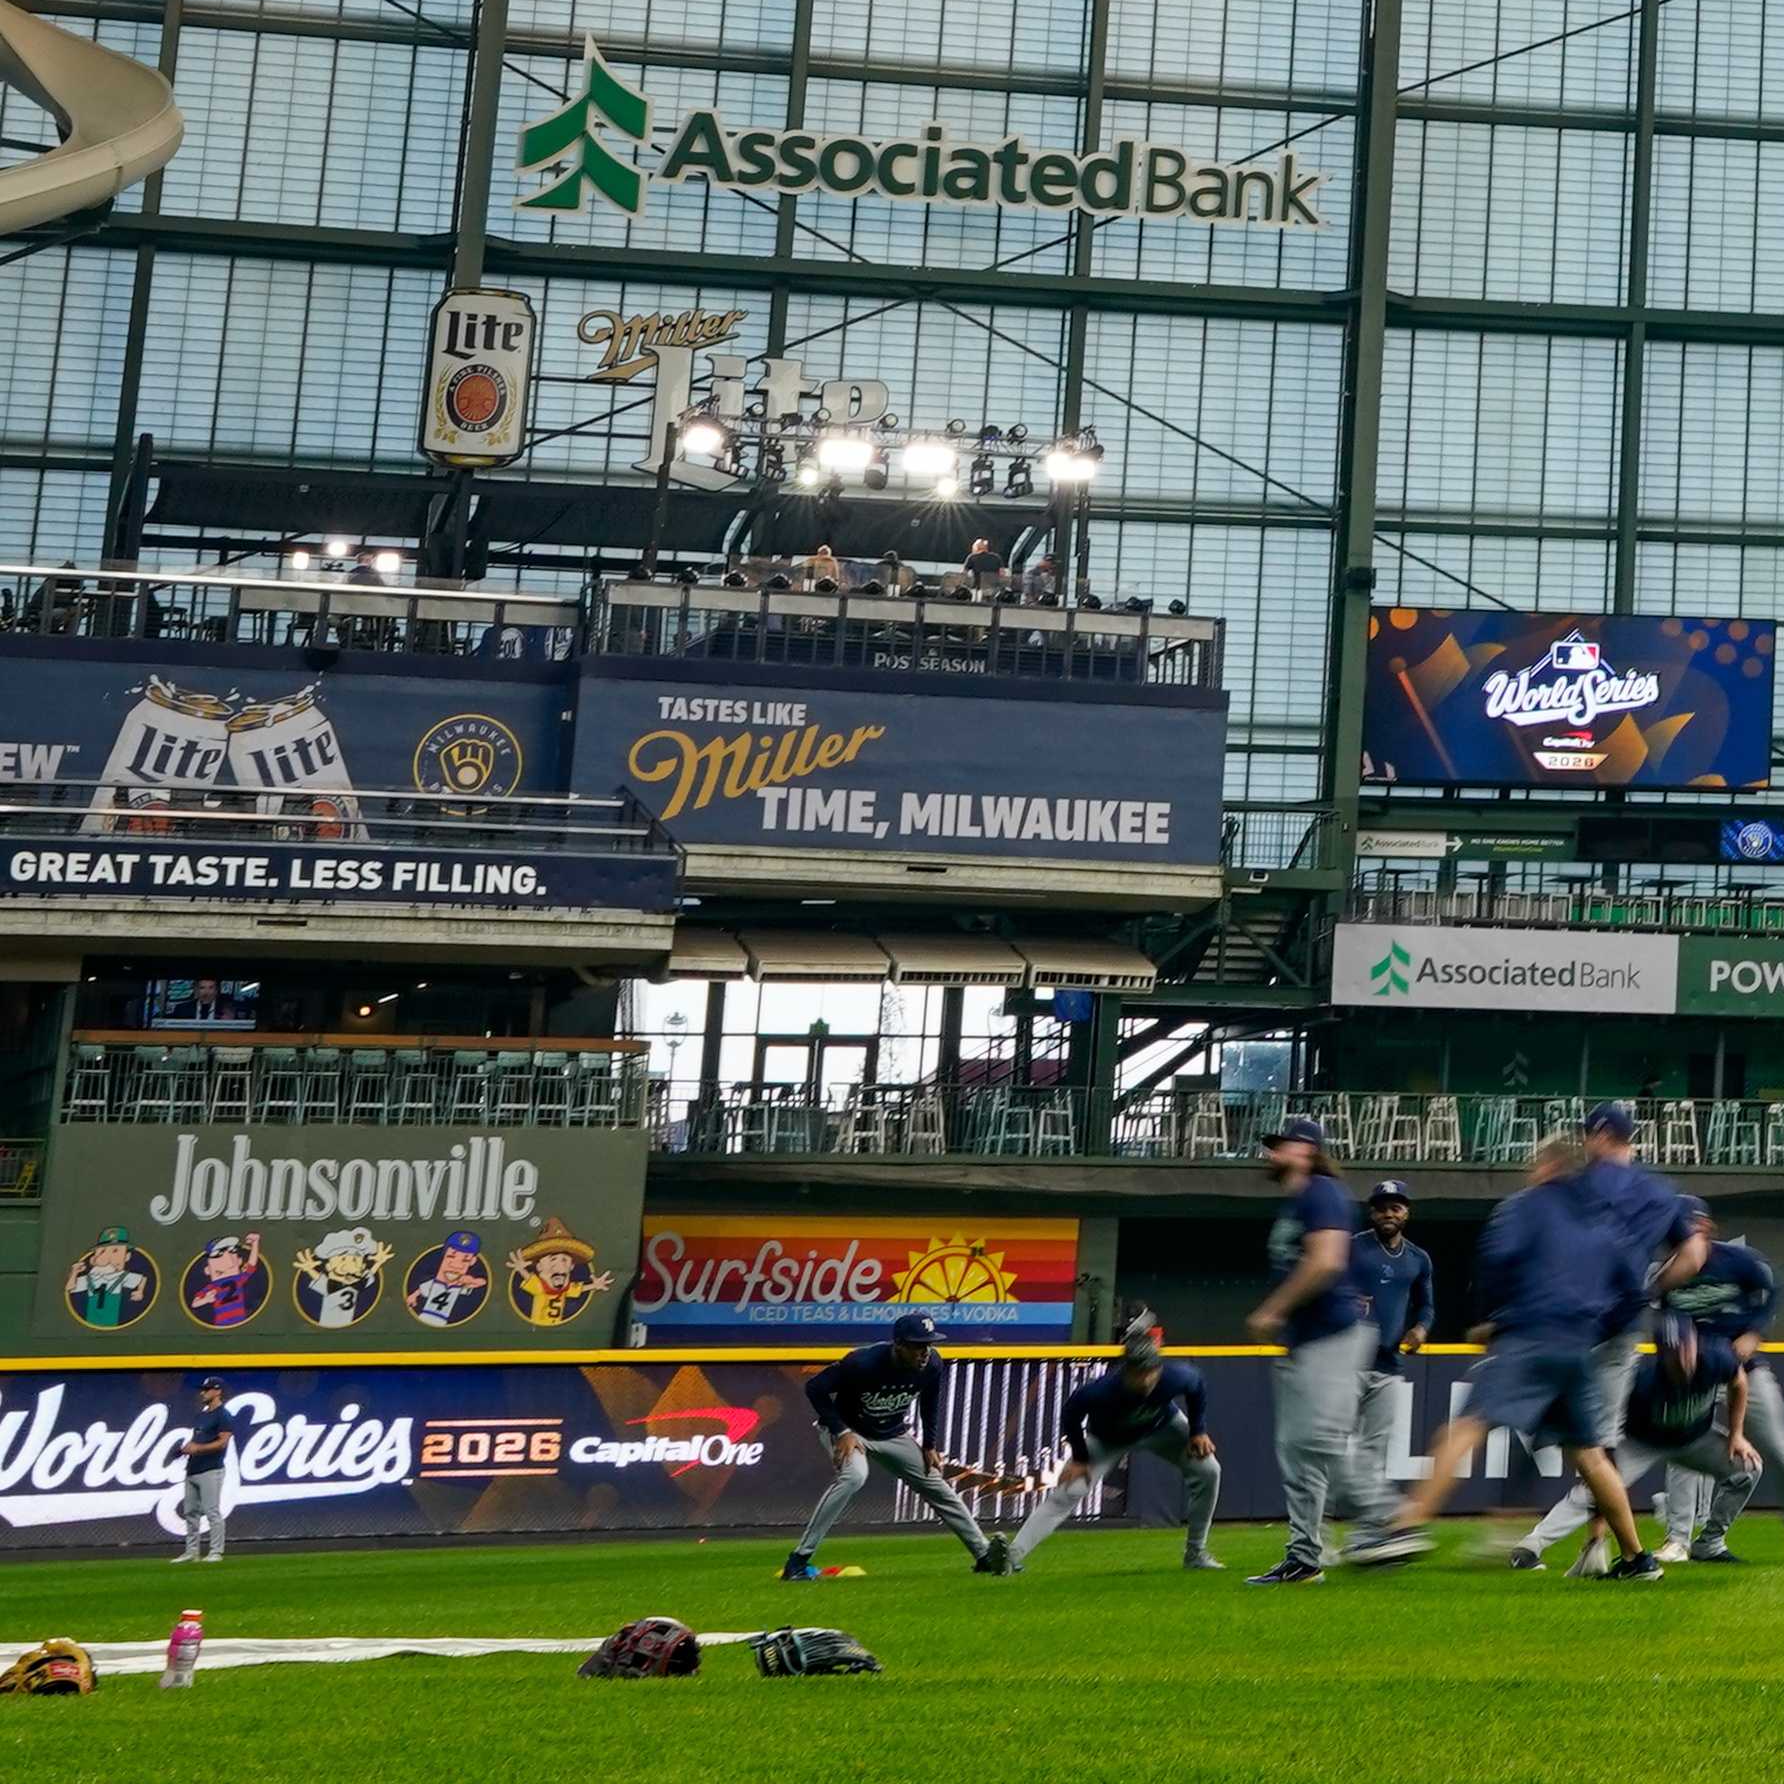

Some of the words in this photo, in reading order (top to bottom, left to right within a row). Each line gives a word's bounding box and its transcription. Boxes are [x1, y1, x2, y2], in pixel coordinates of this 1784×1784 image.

[442, 310, 525, 361] Lite
[577, 308, 749, 371] Miller
[631, 343, 890, 492] Lite
[659, 697, 748, 725] TASTES
[752, 701, 807, 727] LIKE
[1484, 671, 1584, 719] World
[1568, 669, 1660, 727] Series
[126, 722, 225, 783] Lite
[247, 729, 337, 788] Lite
[425, 722, 513, 756] MILWAUKEE
[1548, 756, 1595, 768] 2026
[627, 724, 887, 821] Miller
[757, 787, 890, 840] TIME,
[899, 792, 1172, 845] MILWAUKEE
[10, 851, 140, 884] GREAT
[149, 854, 279, 888] TASTE.
[290, 858, 383, 891] LESS
[392, 861, 547, 896] FILLING.
[150, 1134, 540, 1226] Johnsonville
[633, 1230, 883, 1314] Surfside
[749, 1306, 789, 1322] ICED
[793, 1306, 835, 1322] TEAS
[961, 1306, 1020, 1322] VODKA
[421, 1430, 561, 1465] 2026
